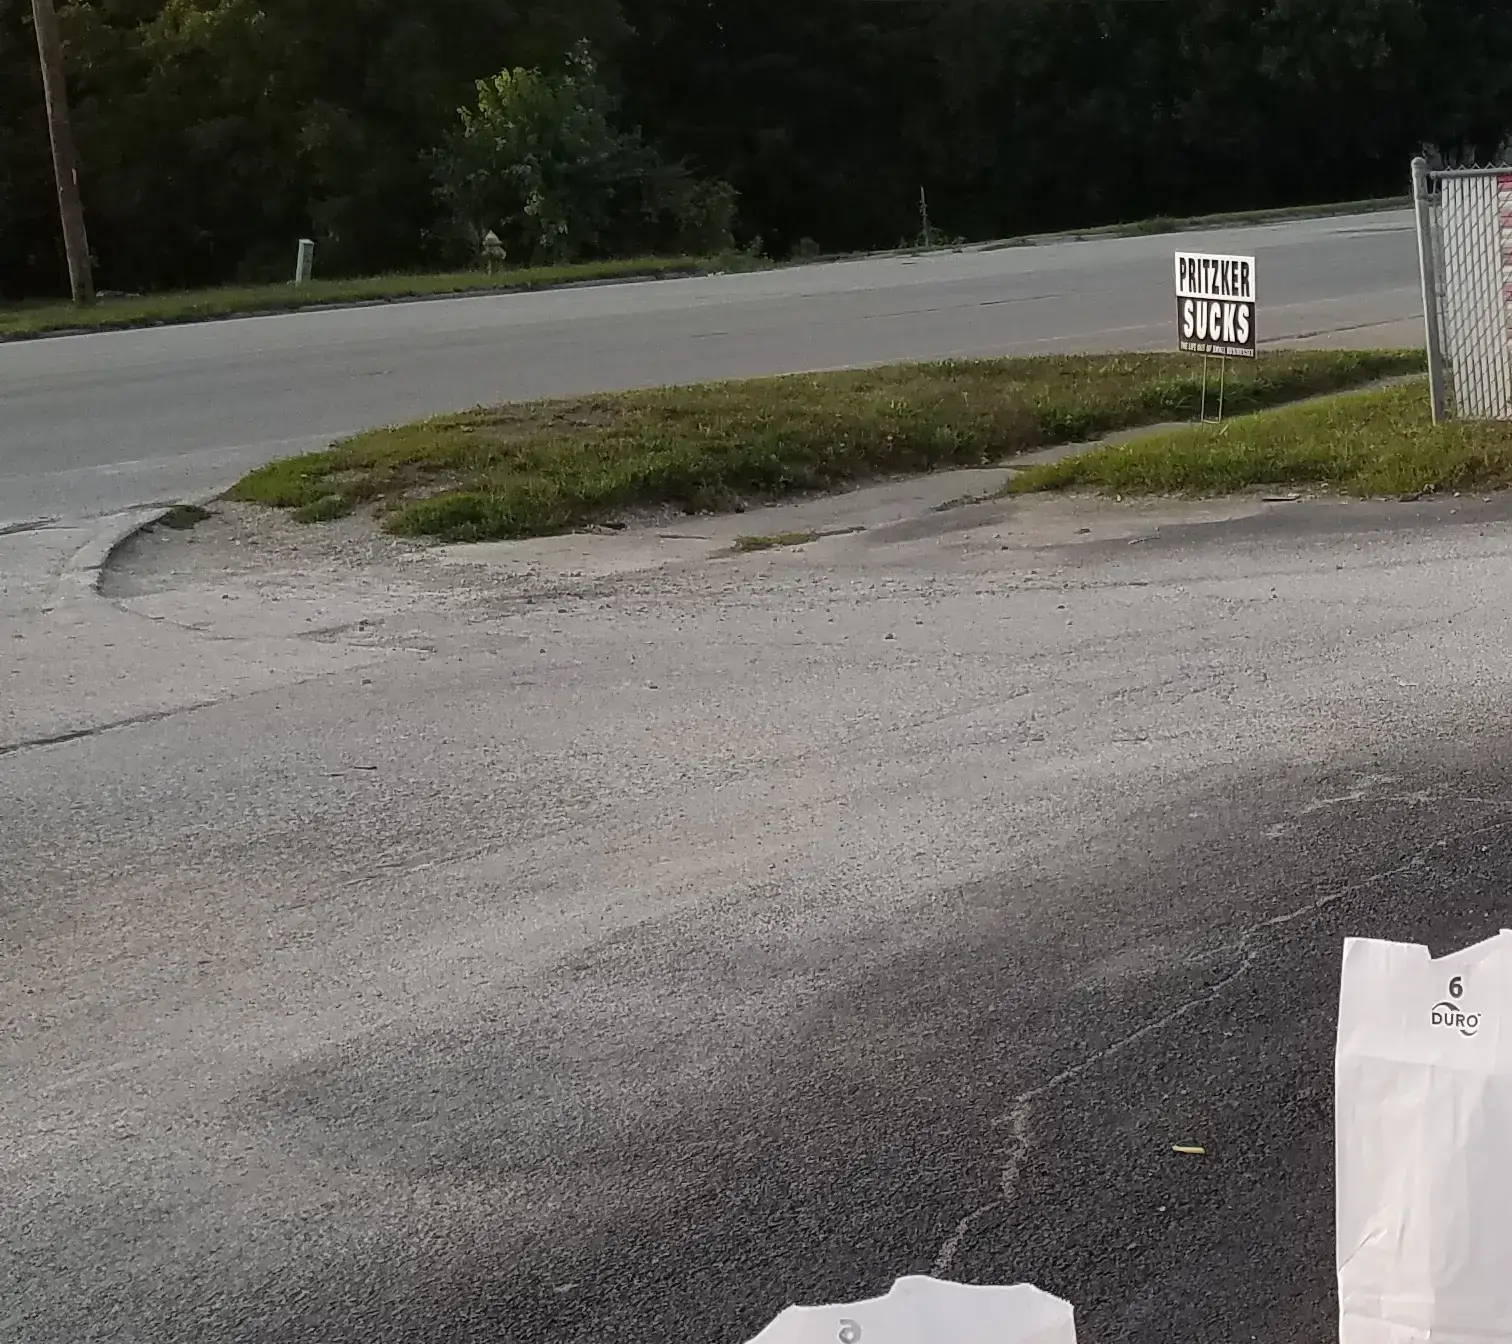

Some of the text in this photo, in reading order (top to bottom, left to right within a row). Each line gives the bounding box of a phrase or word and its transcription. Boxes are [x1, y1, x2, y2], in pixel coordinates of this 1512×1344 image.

[1179, 256, 1250, 297] PRITZKER
[1183, 299, 1250, 343] SUCKS
[1449, 976, 1463, 998] 6
[1432, 1012, 1478, 1027] DURO
